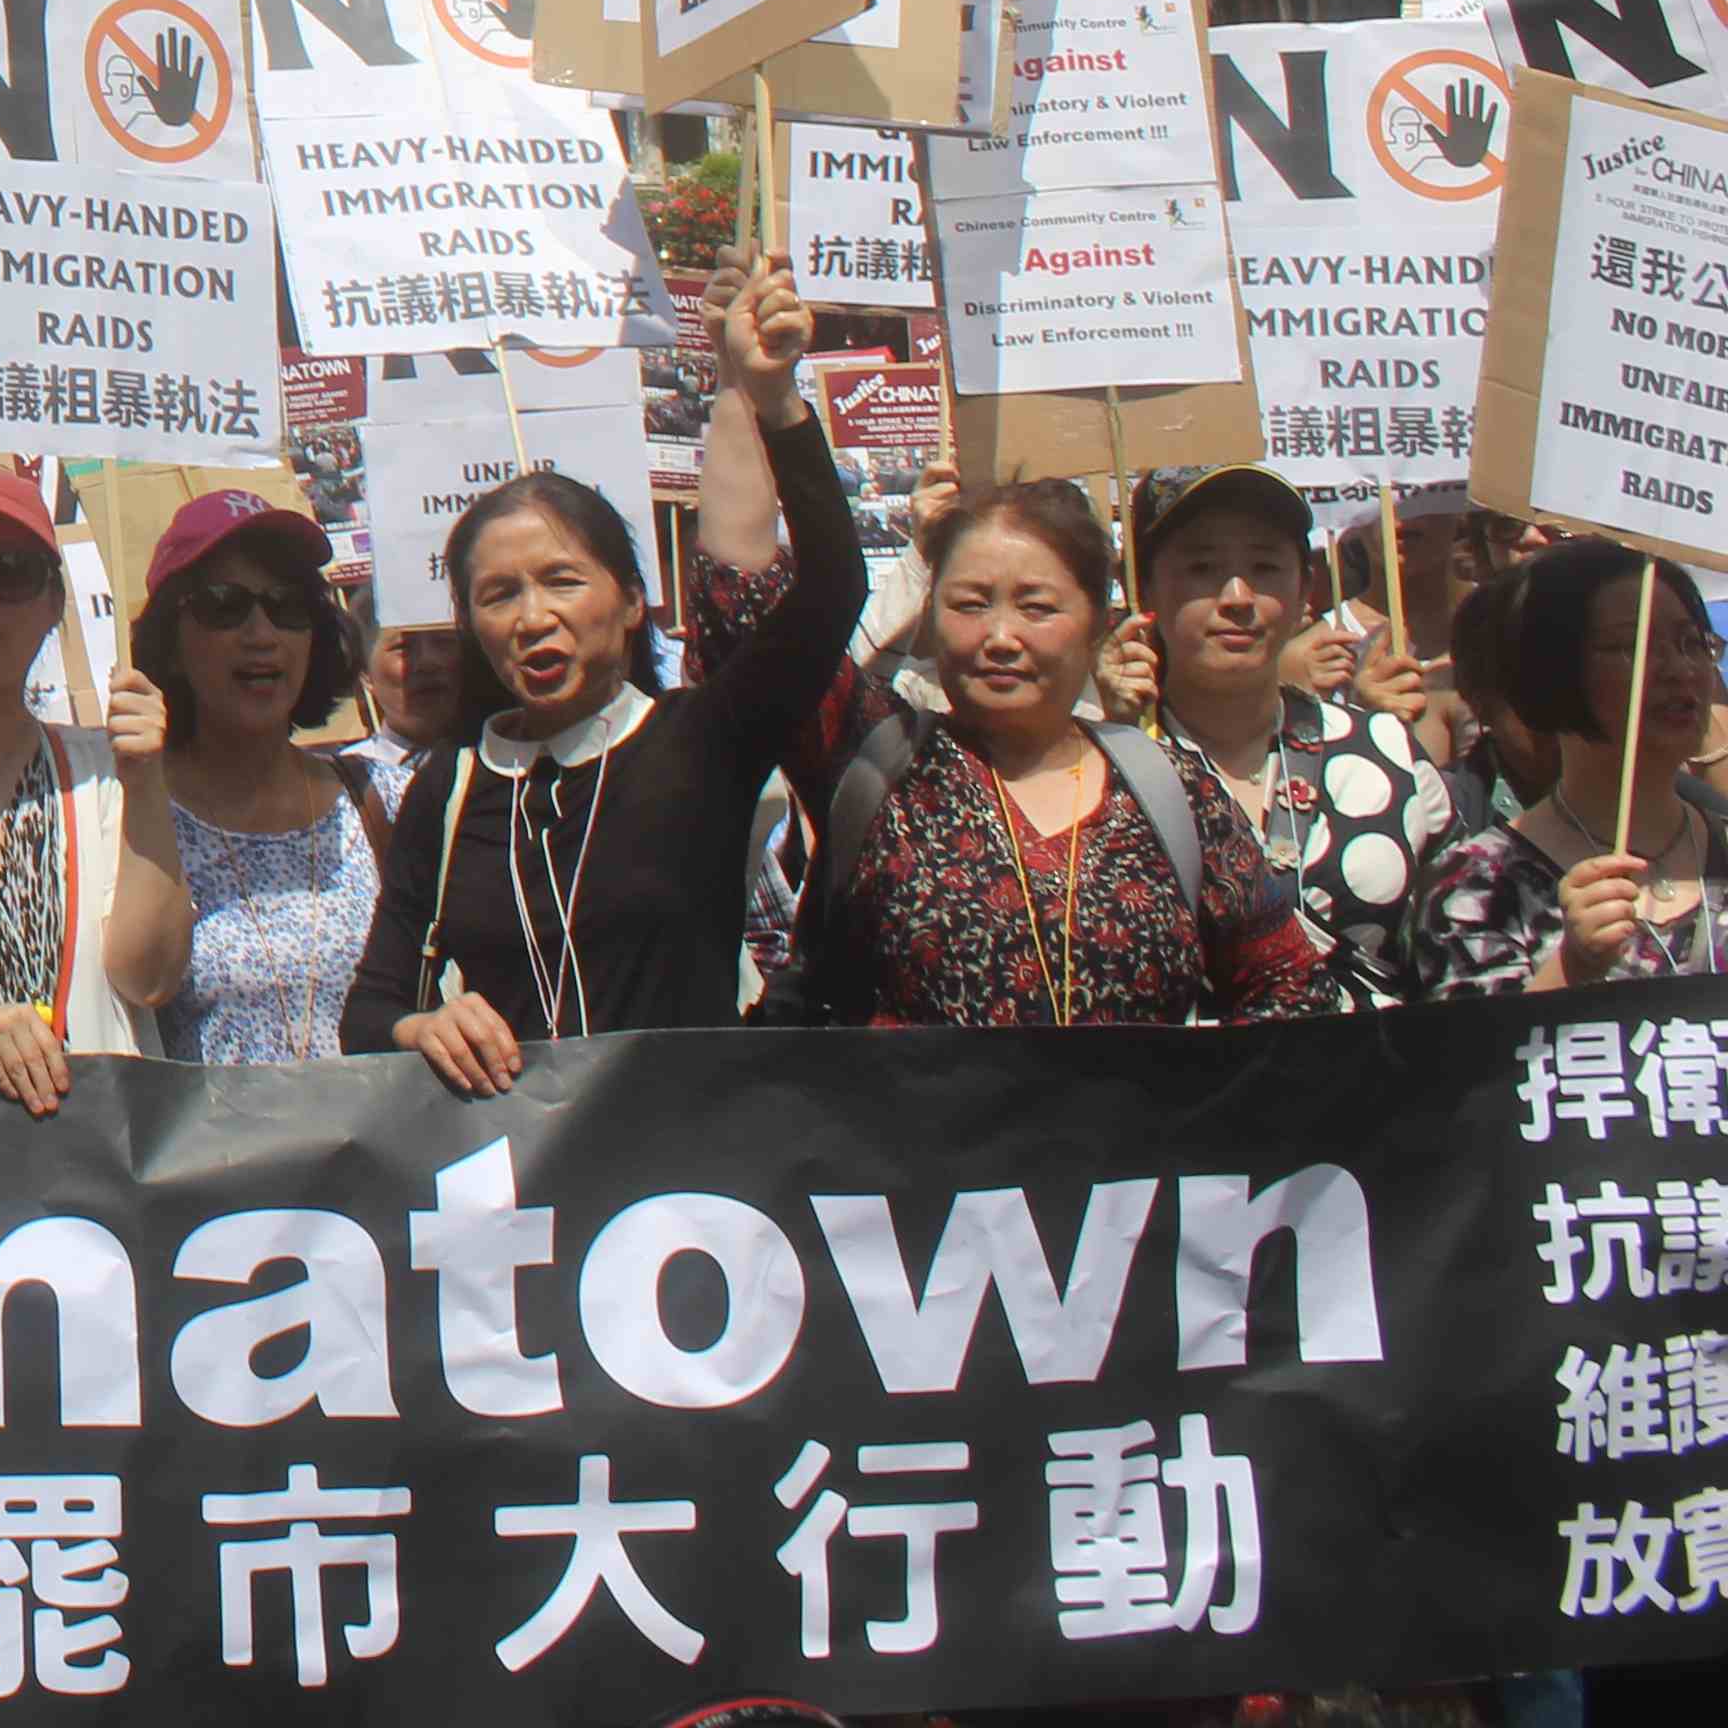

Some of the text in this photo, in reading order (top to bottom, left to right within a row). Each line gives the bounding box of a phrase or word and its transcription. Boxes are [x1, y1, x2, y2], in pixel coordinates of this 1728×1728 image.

[1080, 18, 1128, 29] Centre
[1096, 92, 1188, 110] & Violent
[297, 135, 604, 170] HEAVY-HANDED
[969, 136, 1009, 152] Law
[1017, 128, 1145, 148] Enforcement
[1582, 135, 1666, 180] Justice
[1651, 157, 1728, 198] CHINA
[321, 180, 604, 217] IMMIGRATION
[955, 210, 1157, 234] Chinese Community Centre
[419, 227, 535, 259] RAIDS
[1024, 243, 1156, 275] Against
[1591, 233, 1728, 313] 還我公
[323, 269, 650, 330] 抗議粗暴執法
[965, 290, 1214, 317] Discriminatory & Violent
[36, 312, 155, 353] RAIDS
[992, 332, 1034, 347] Law
[1042, 324, 1171, 344] Enforcement
[1610, 308, 1658, 340] NO
[1320, 359, 1441, 389] RAIDS
[1560, 401, 1728, 466] IMMIGRAT
[1621, 470, 1713, 515] RAIDS
